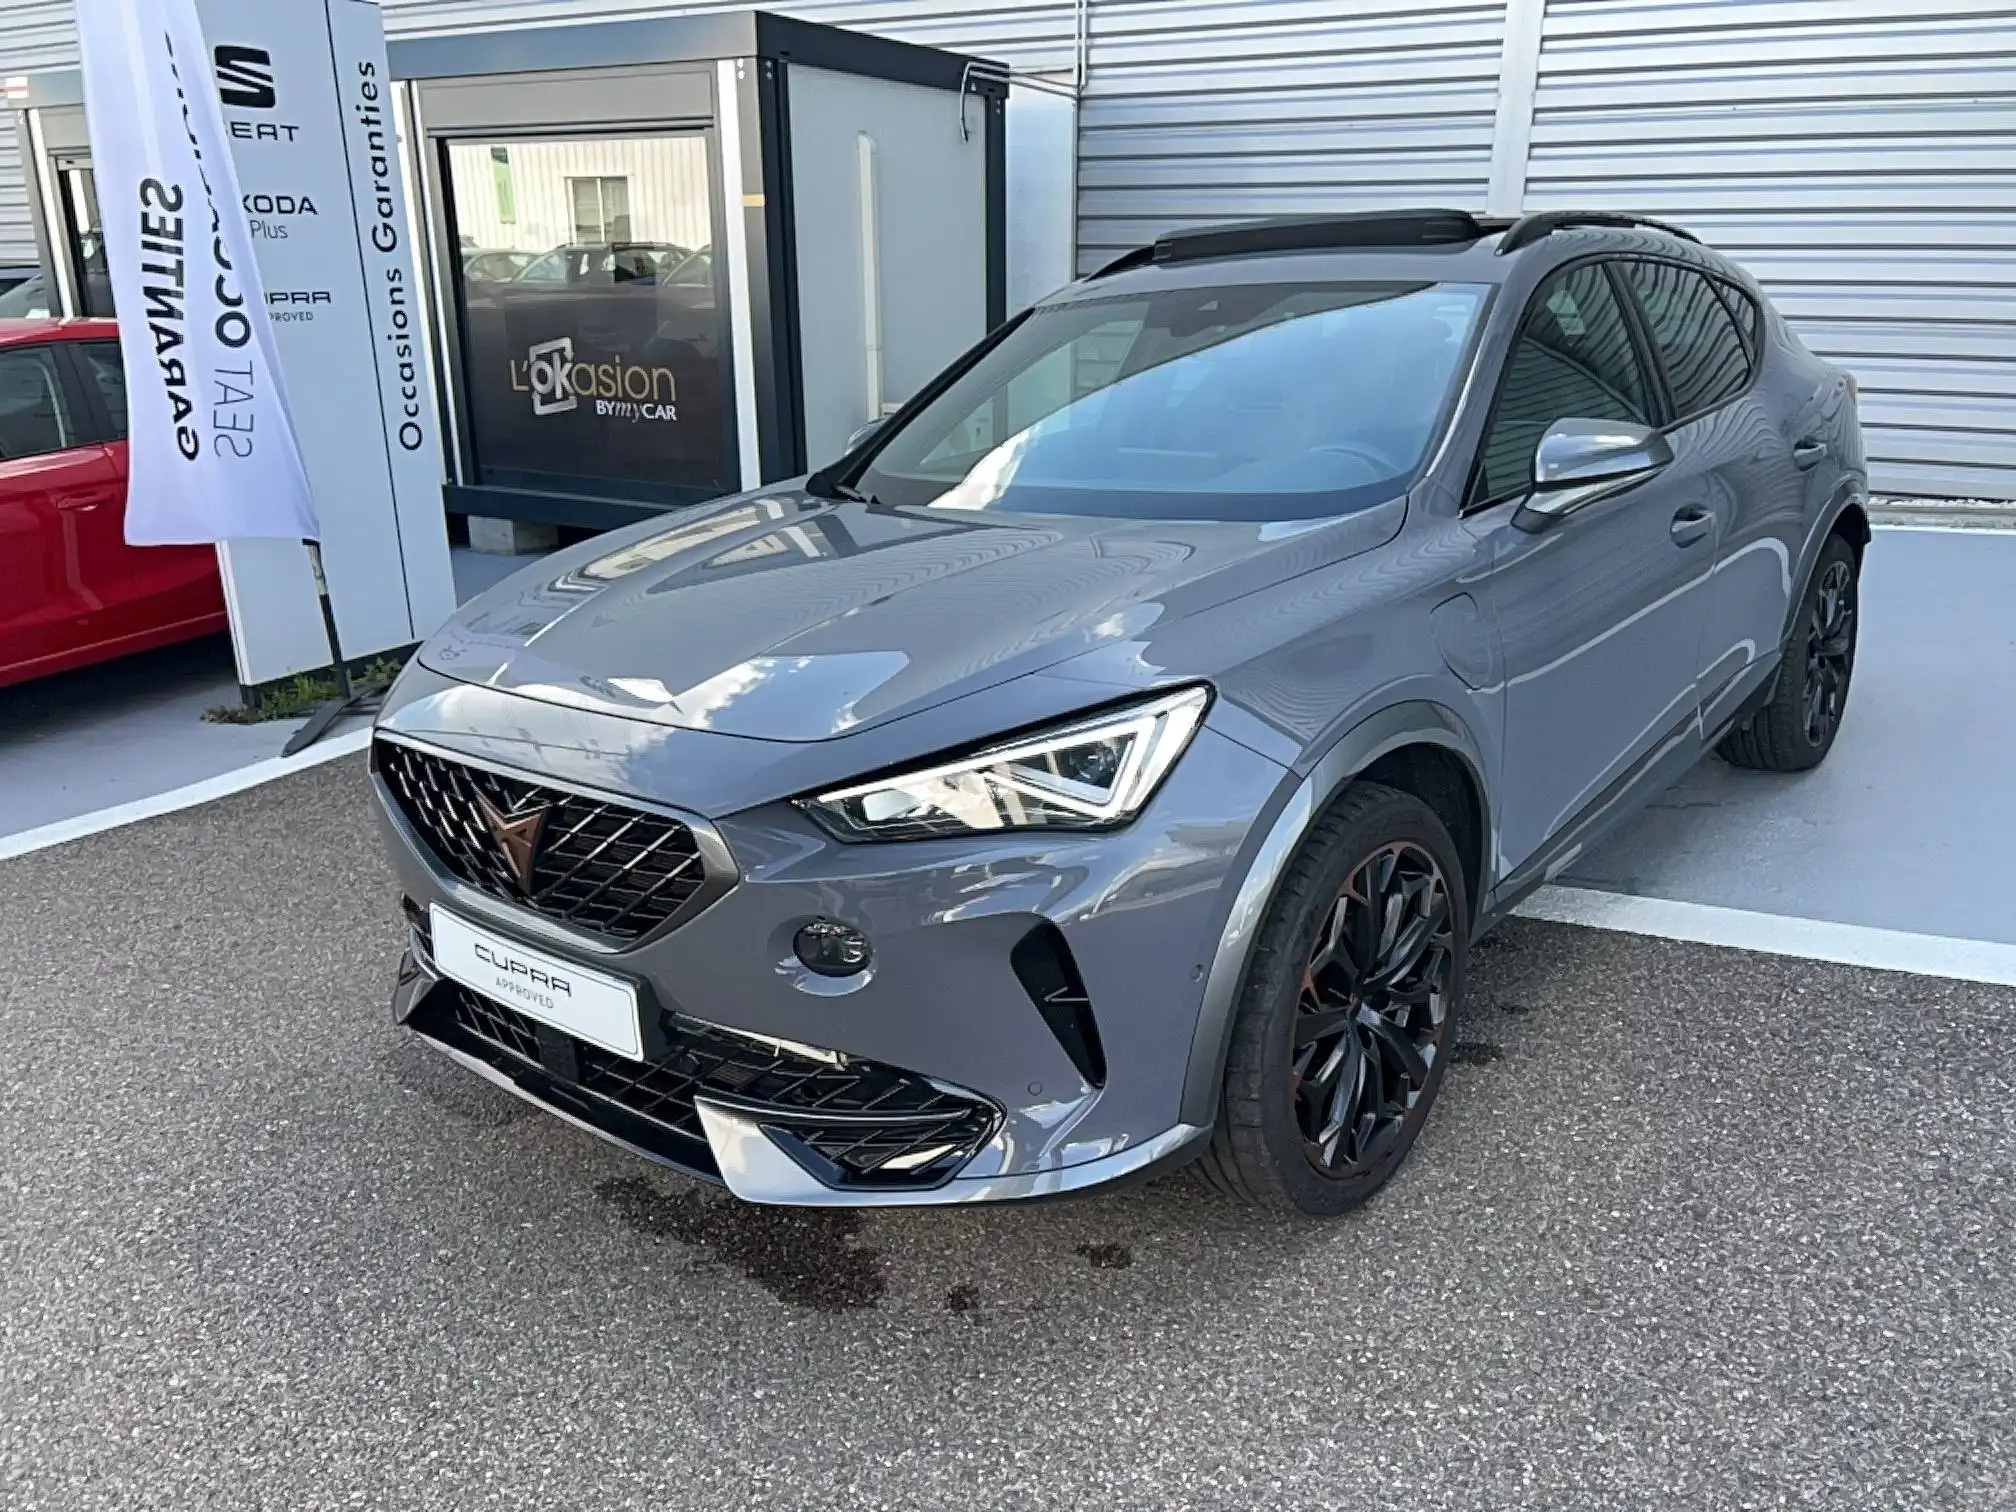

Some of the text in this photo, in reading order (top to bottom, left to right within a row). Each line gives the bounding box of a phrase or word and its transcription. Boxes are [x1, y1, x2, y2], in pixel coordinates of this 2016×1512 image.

[227, 121, 299, 142] EAT
[241, 194, 318, 215] KODA
[249, 219, 288, 239] Plus
[355, 61, 423, 450] Occasions Garanties
[264, 291, 331, 304] PRA
[474, 943, 572, 998] CUPRA
[495, 976, 555, 1009] APPROVED
